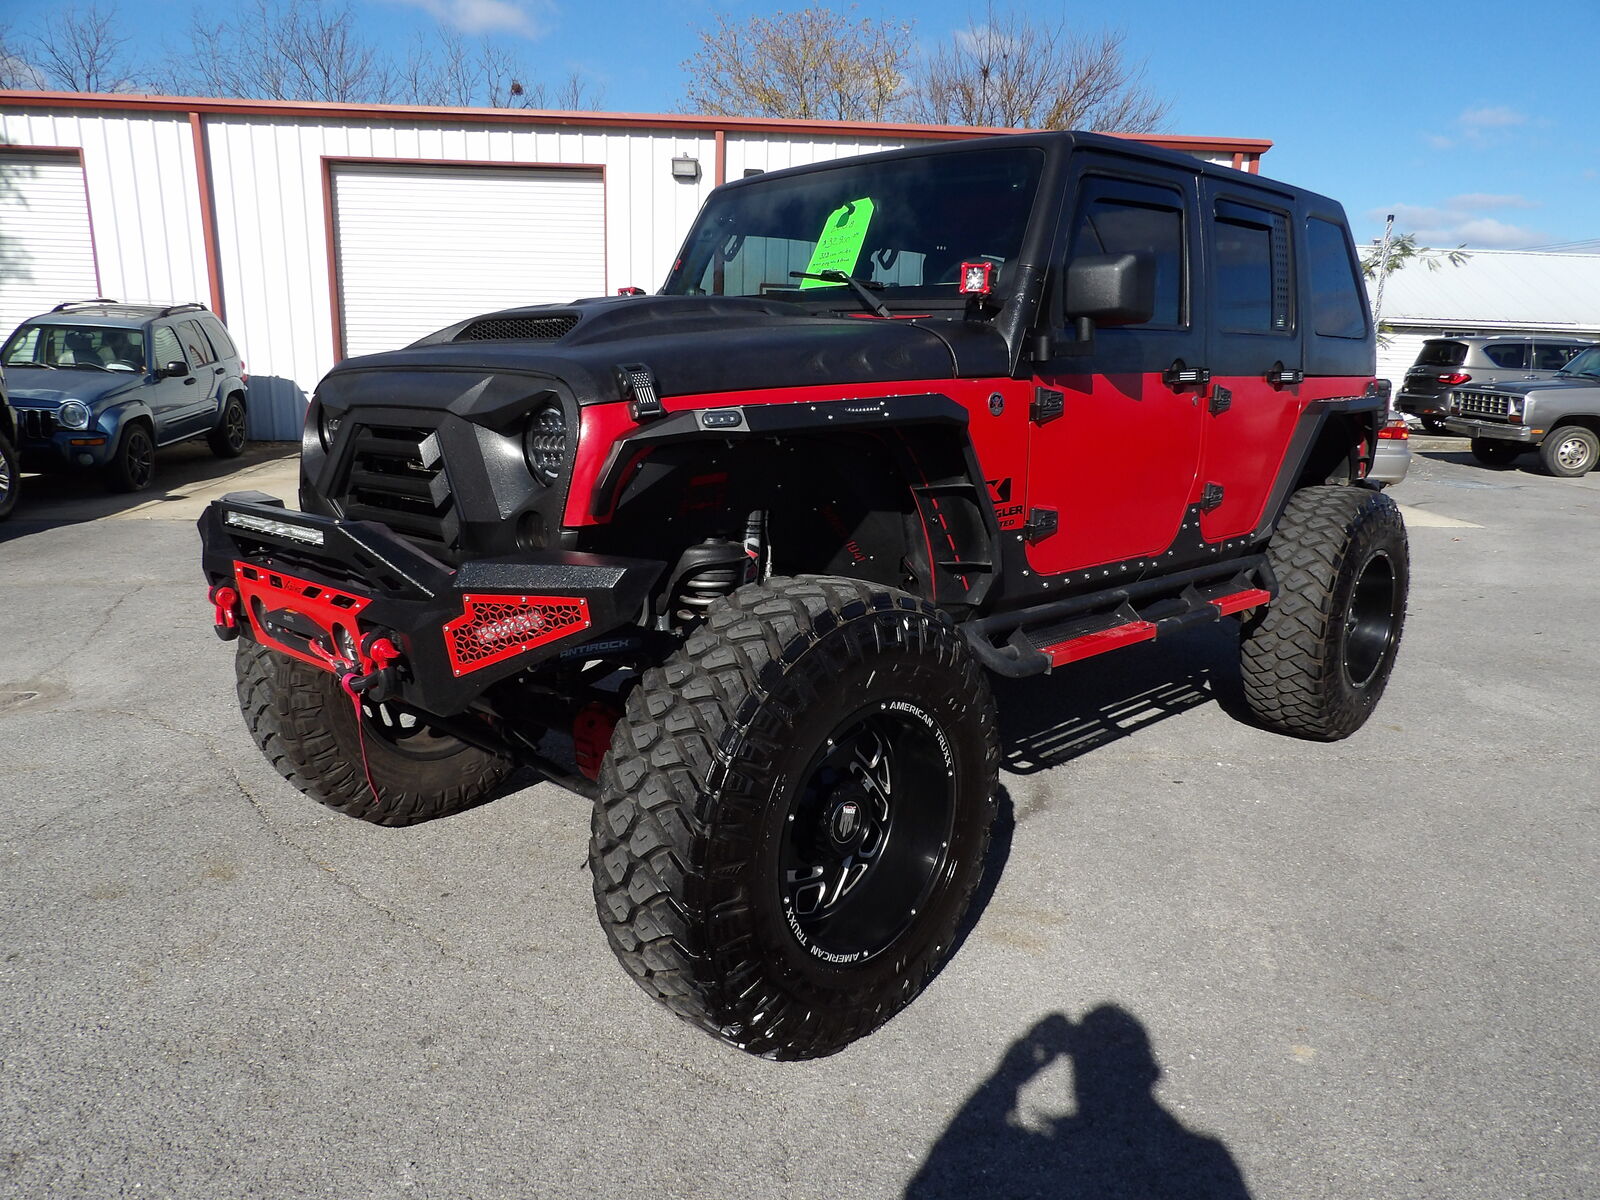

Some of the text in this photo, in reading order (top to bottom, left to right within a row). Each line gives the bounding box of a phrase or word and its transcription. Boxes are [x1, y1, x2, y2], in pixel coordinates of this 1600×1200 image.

[995, 505, 1024, 518] GLER
[560, 639, 629, 658] ANTIROCK
[889, 701, 953, 767] AMERICAN TRUXX
[785, 906, 860, 963] AMERICAN TRUXX
